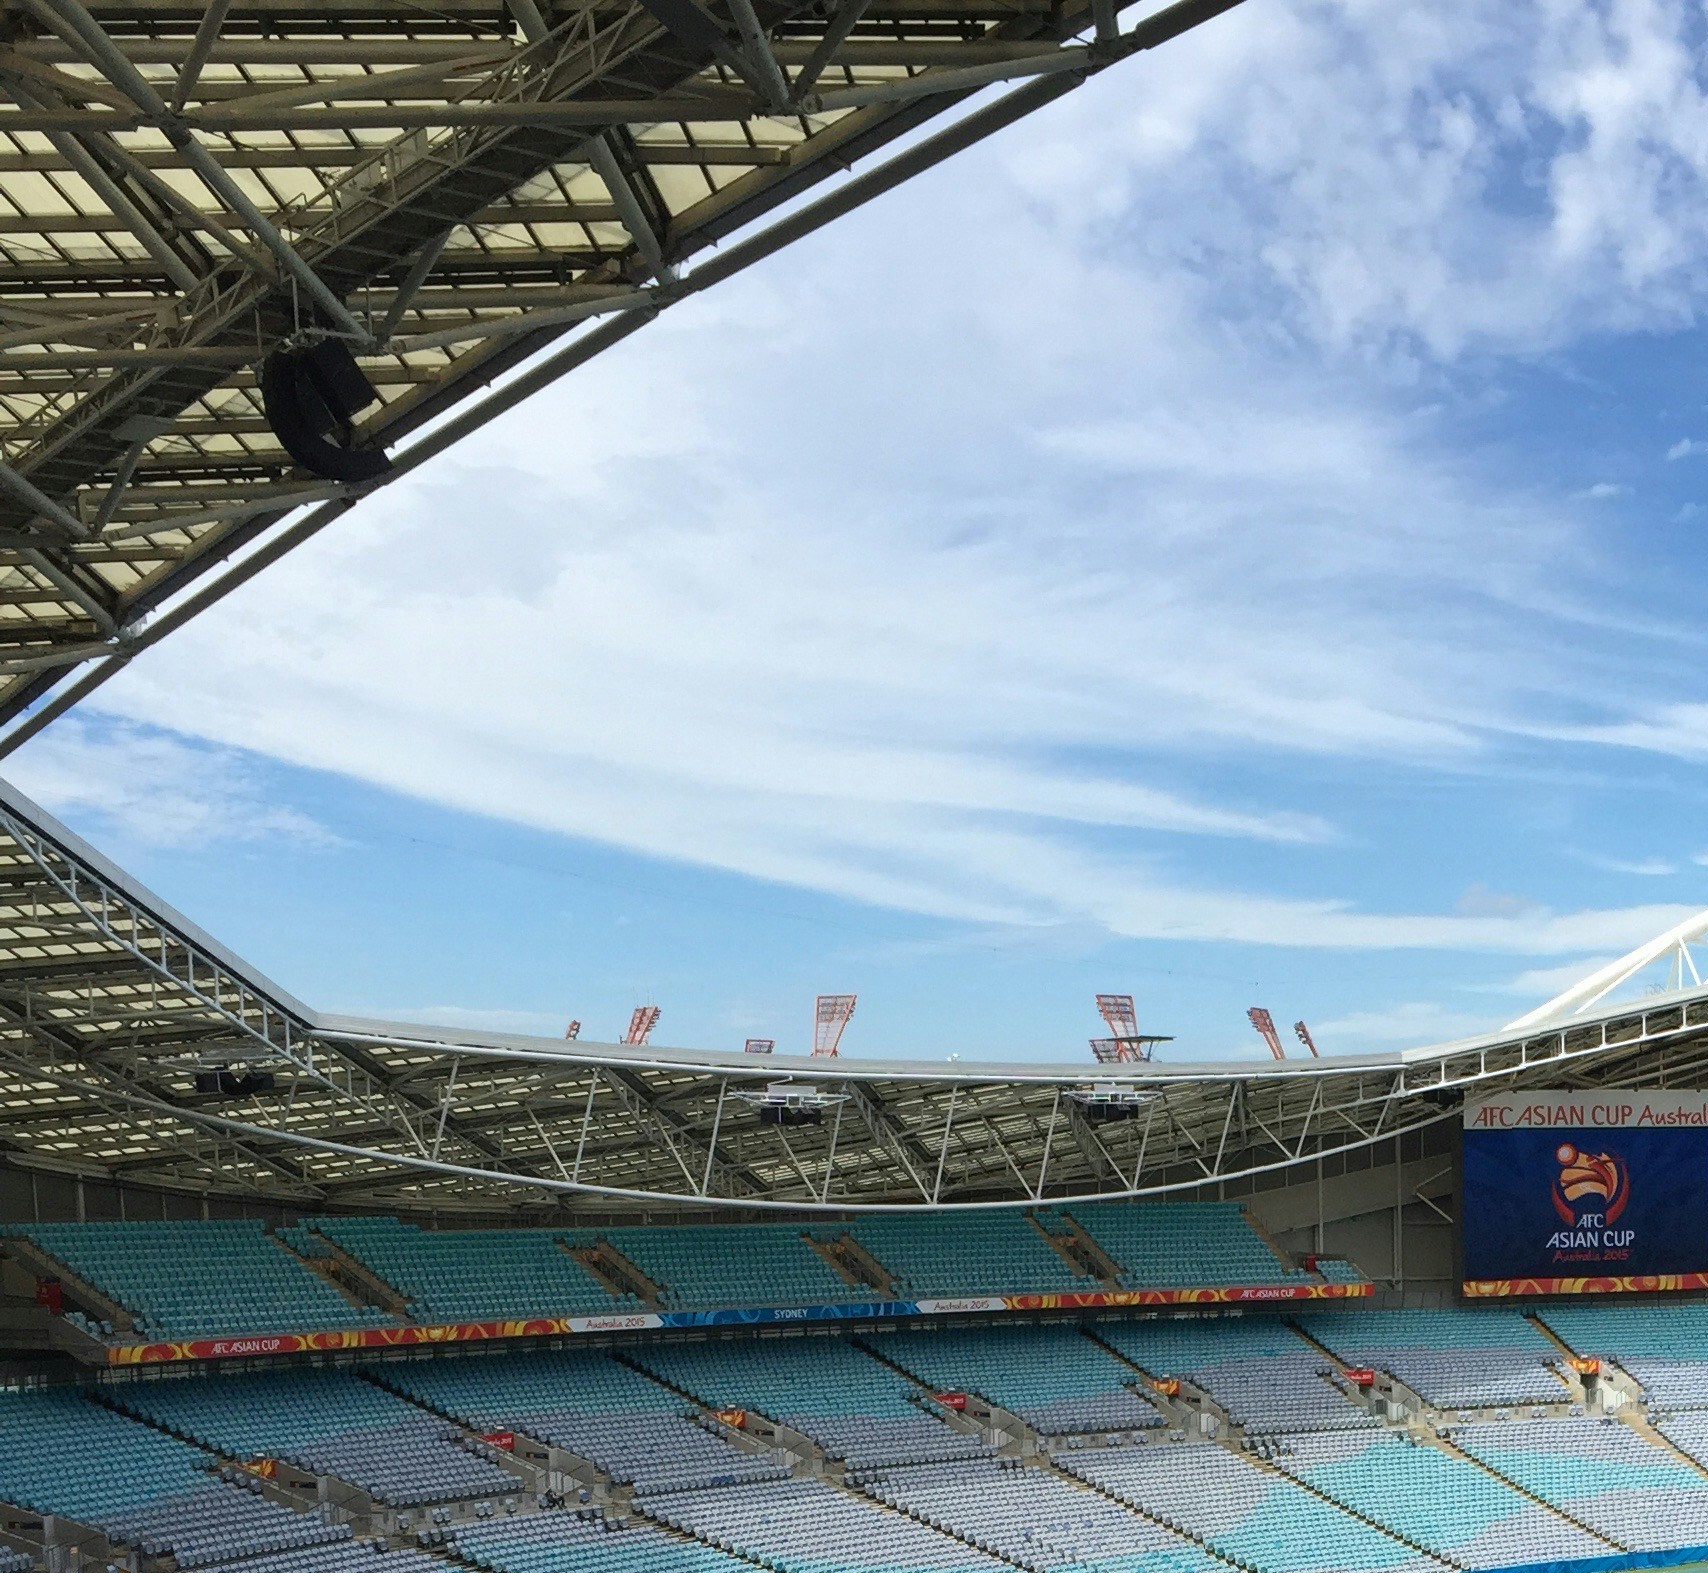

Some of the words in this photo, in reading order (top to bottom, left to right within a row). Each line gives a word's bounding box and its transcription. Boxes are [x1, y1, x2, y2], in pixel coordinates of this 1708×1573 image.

[1473, 1106, 1513, 1127] AFC
[1515, 1105, 1583, 1126] ASIAN
[1591, 1105, 1633, 1125] CUP
[1576, 1214, 1604, 1229] AFC
[1546, 1232, 1599, 1249] ASIAN
[1604, 1230, 1635, 1247] CUP
[1603, 1249, 1631, 1260] 2015
[774, 1309, 808, 1319] SYDNEY
